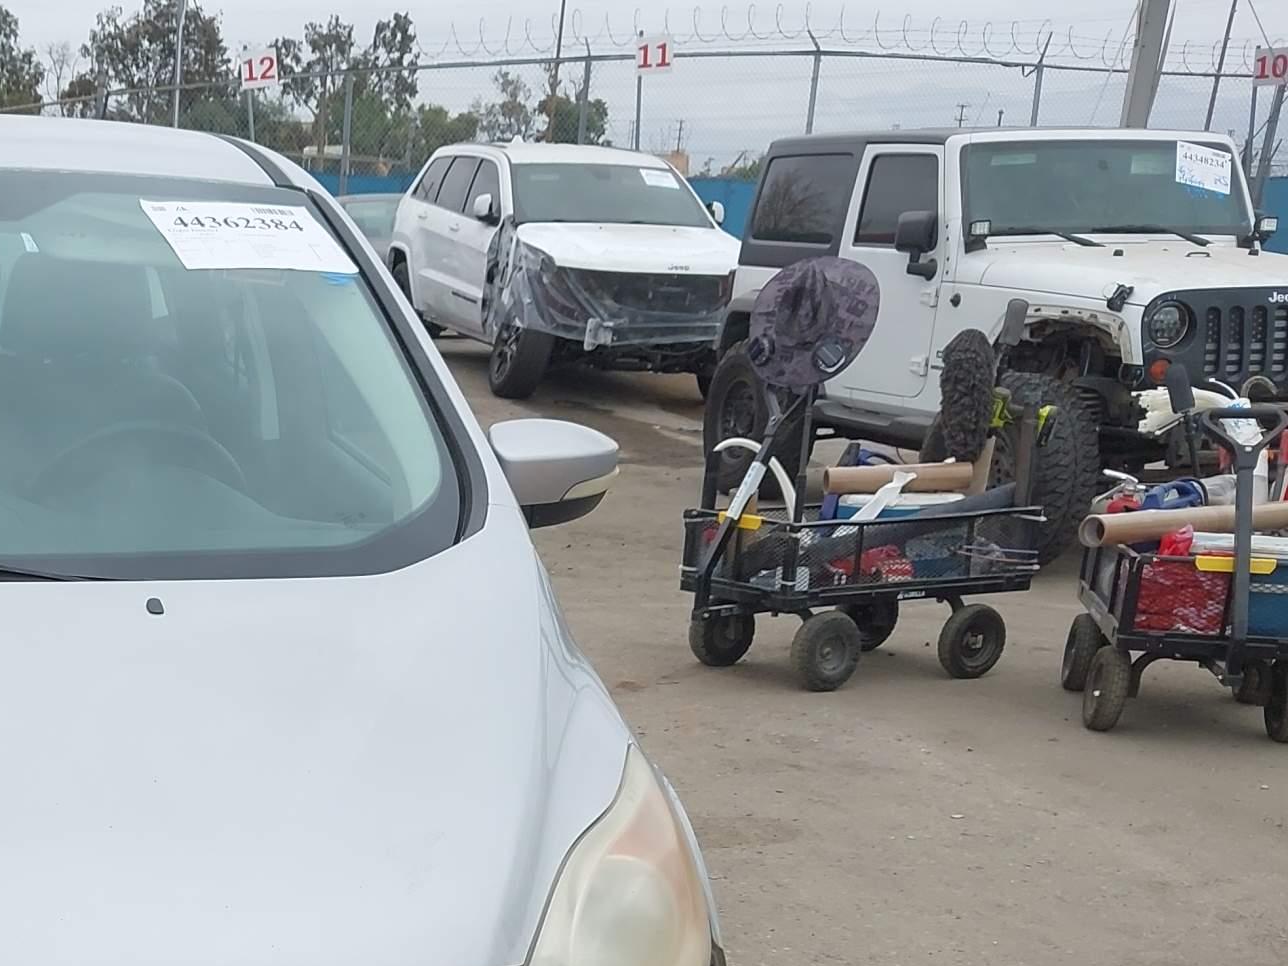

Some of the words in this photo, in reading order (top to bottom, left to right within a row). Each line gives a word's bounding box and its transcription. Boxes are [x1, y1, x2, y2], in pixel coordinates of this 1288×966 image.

[638, 42, 671, 68] 11
[1255, 54, 1288, 78] 10
[243, 56, 275, 81] 12
[174, 216, 304, 232] 44362384
